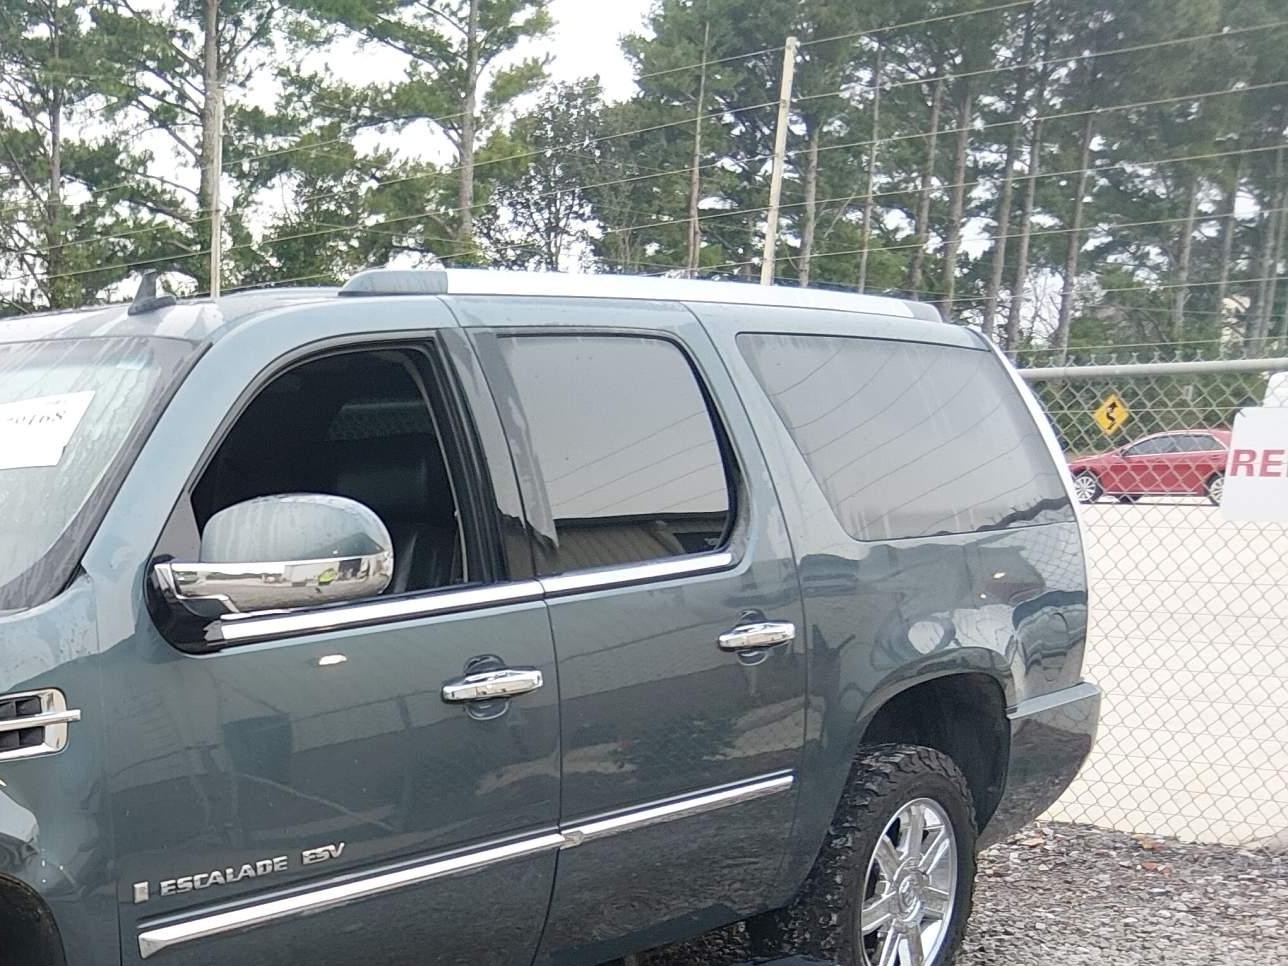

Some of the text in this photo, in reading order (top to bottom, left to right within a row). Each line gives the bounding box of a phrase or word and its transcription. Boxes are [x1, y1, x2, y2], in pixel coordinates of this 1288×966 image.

[1229, 449, 1288, 478] RE
[160, 842, 345, 897] ESCALADE ESV
